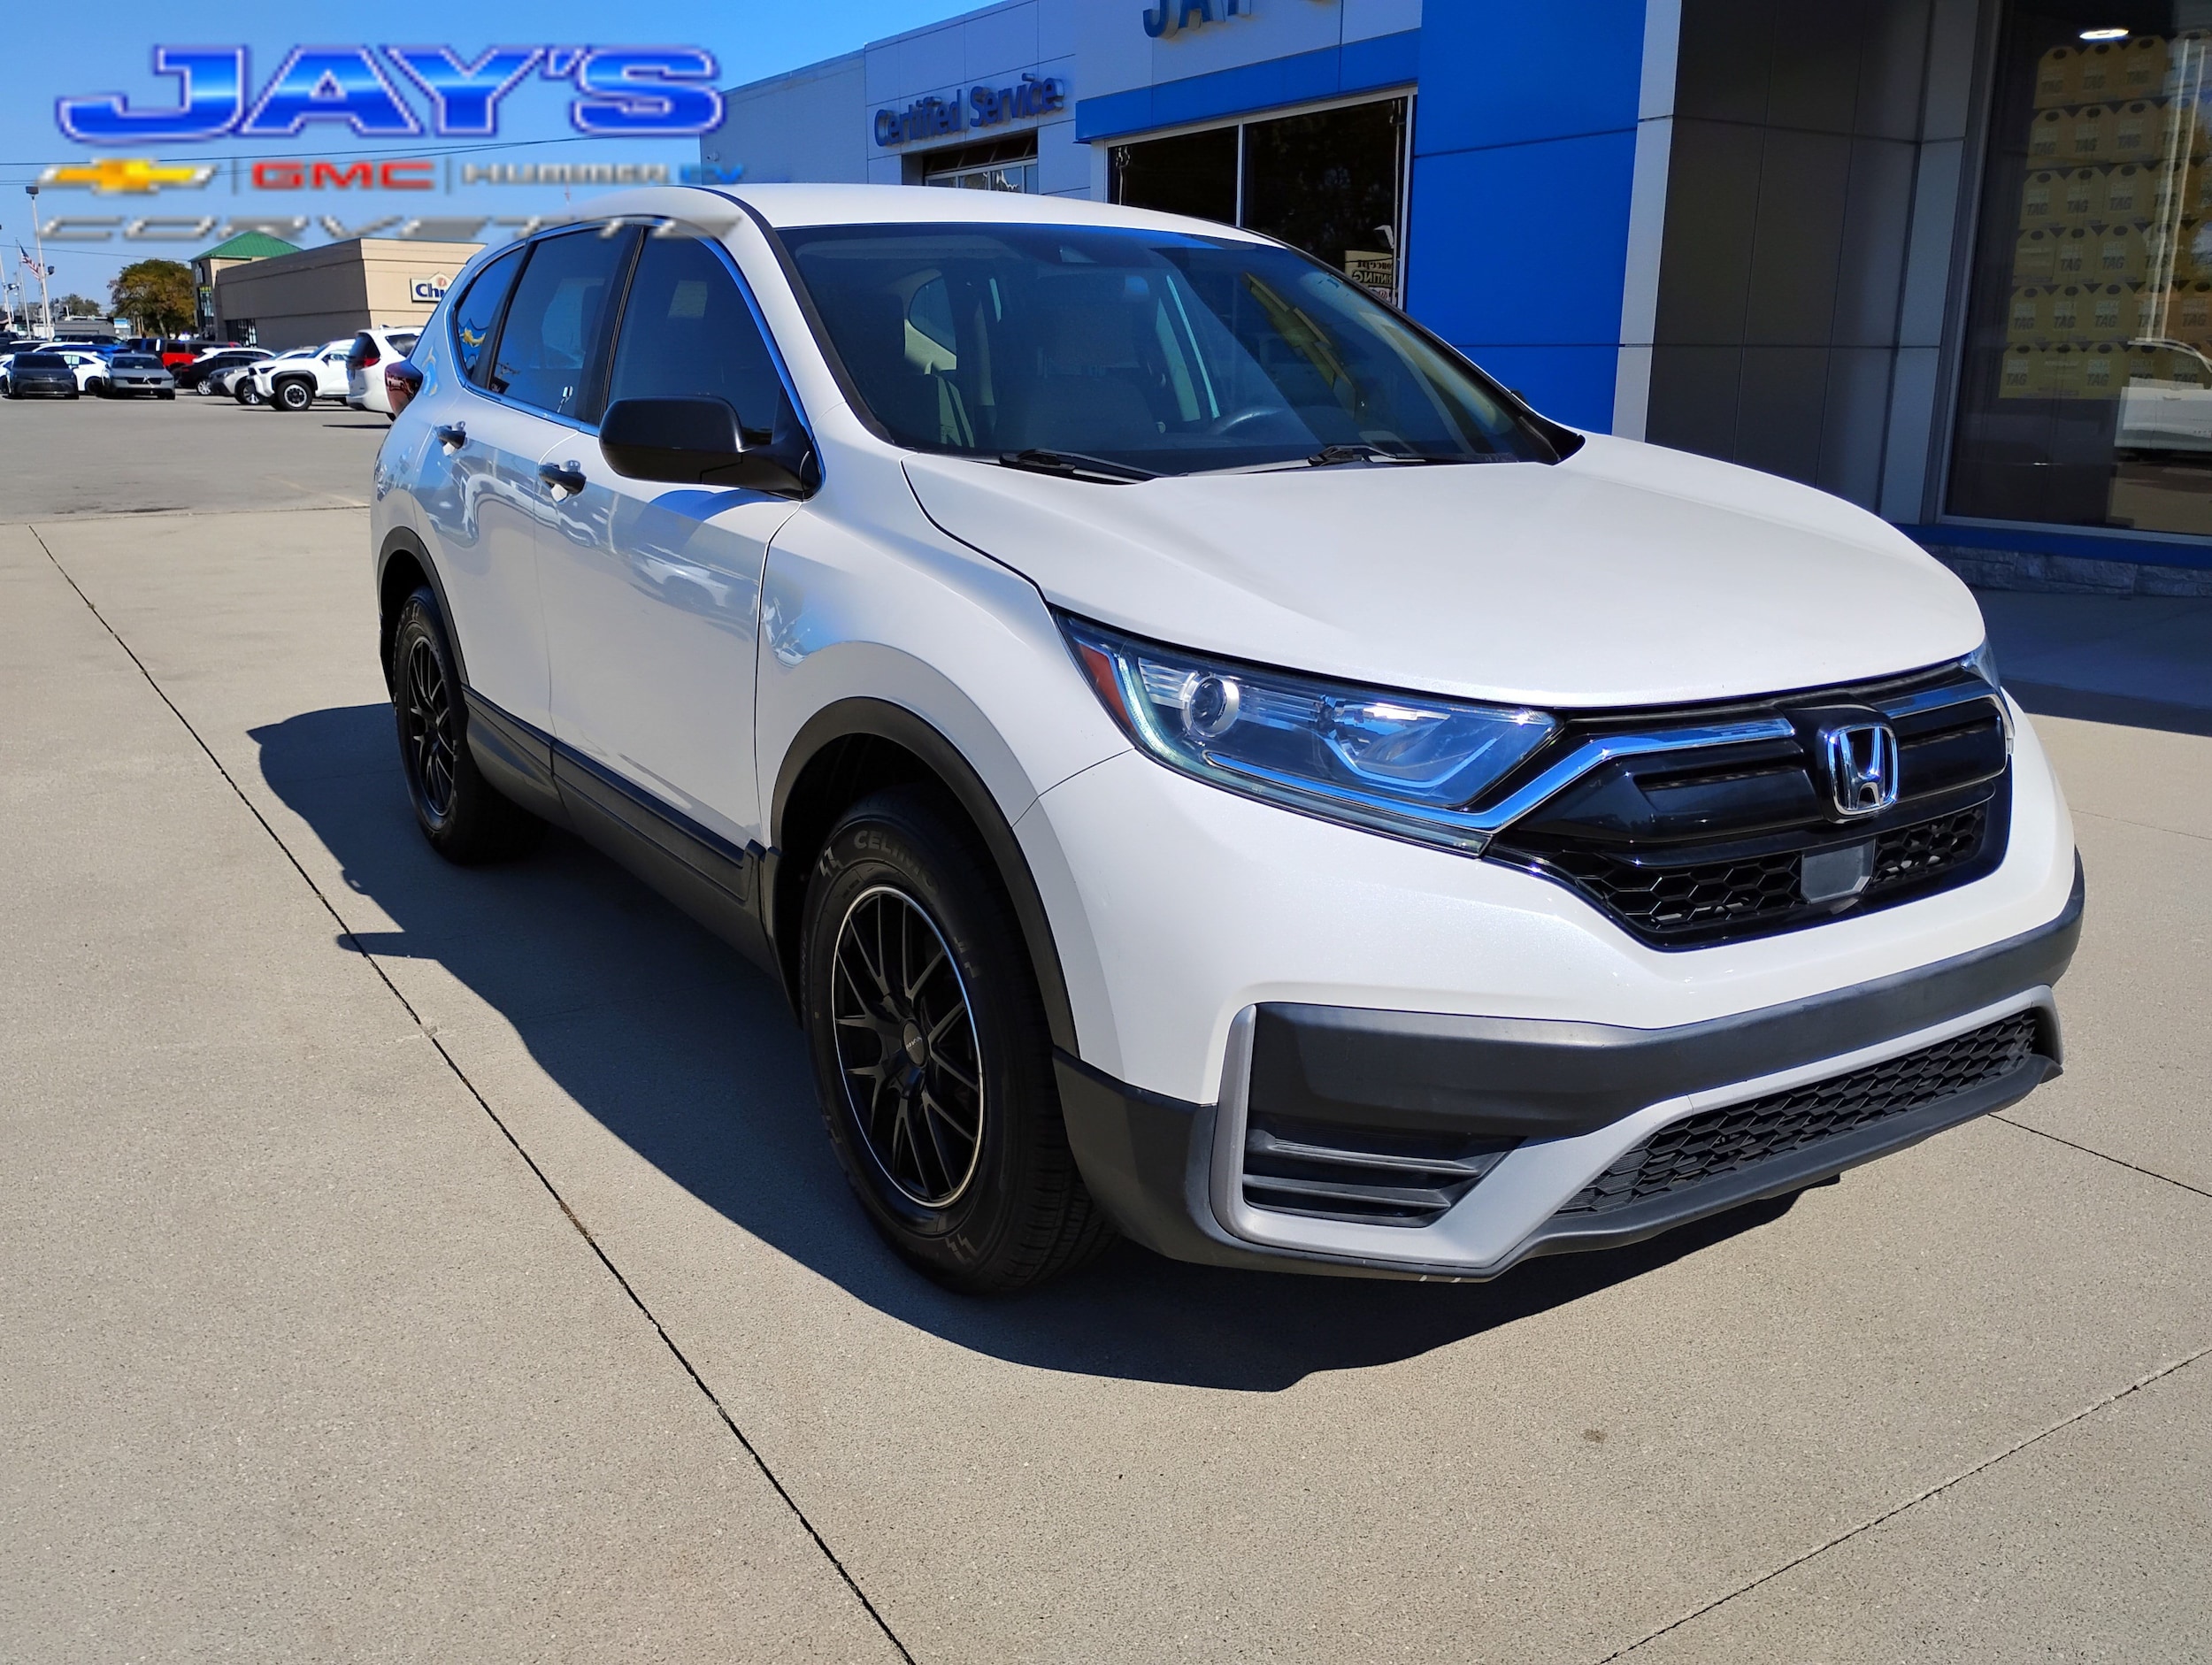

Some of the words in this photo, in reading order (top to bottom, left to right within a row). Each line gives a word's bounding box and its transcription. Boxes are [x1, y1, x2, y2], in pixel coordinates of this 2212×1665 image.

[873, 88, 968, 147] Certified
[970, 73, 1065, 127] Service
[2014, 317, 2035, 330] TAG
[2054, 316, 2077, 329] TAG
[2095, 315, 2118, 329] TAG
[2006, 373, 2028, 387] TAG
[2086, 373, 2110, 387] TAG
